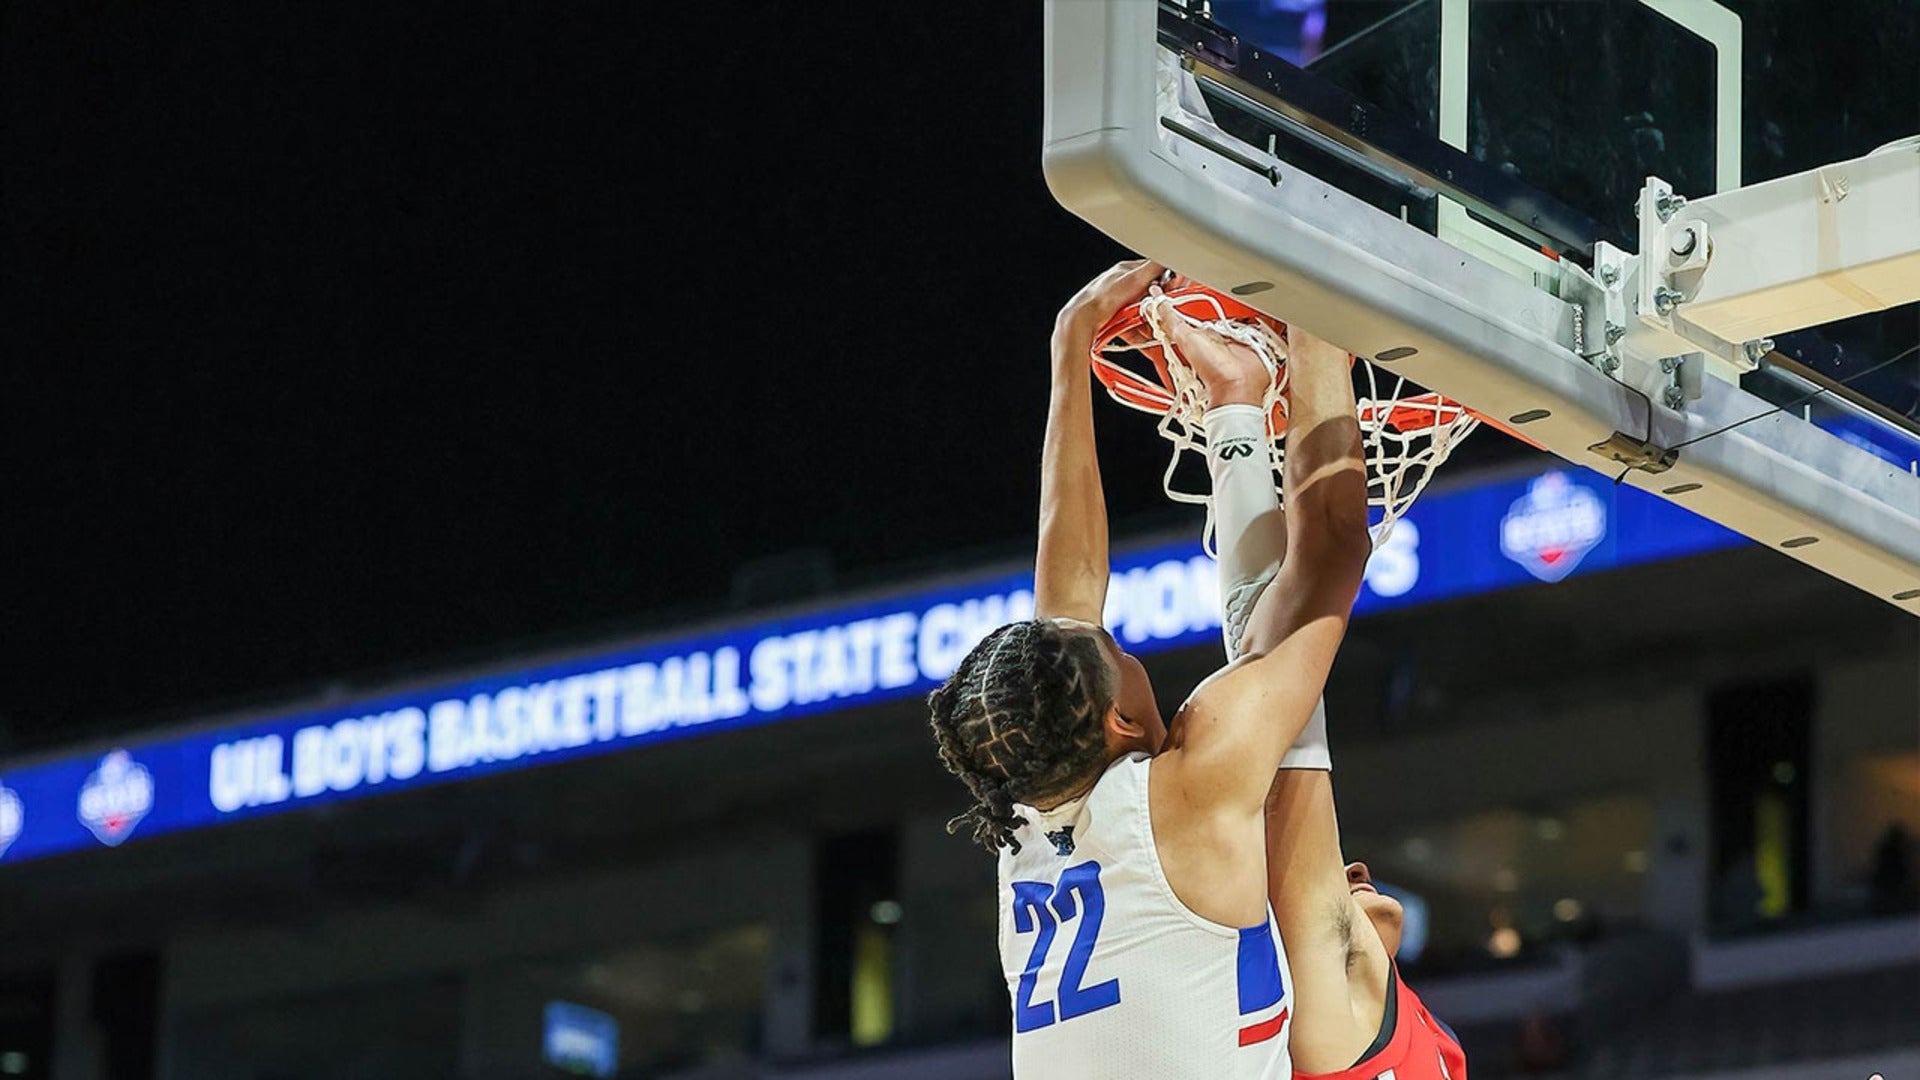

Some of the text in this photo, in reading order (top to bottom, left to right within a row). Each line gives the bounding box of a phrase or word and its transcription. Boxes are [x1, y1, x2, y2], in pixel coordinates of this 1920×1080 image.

[210, 736, 292, 812] UIL
[291, 708, 425, 798] BOYS
[428, 646, 751, 772] BASKETBALL
[748, 612, 917, 711] STATE
[1011, 860, 1121, 1034] 22
